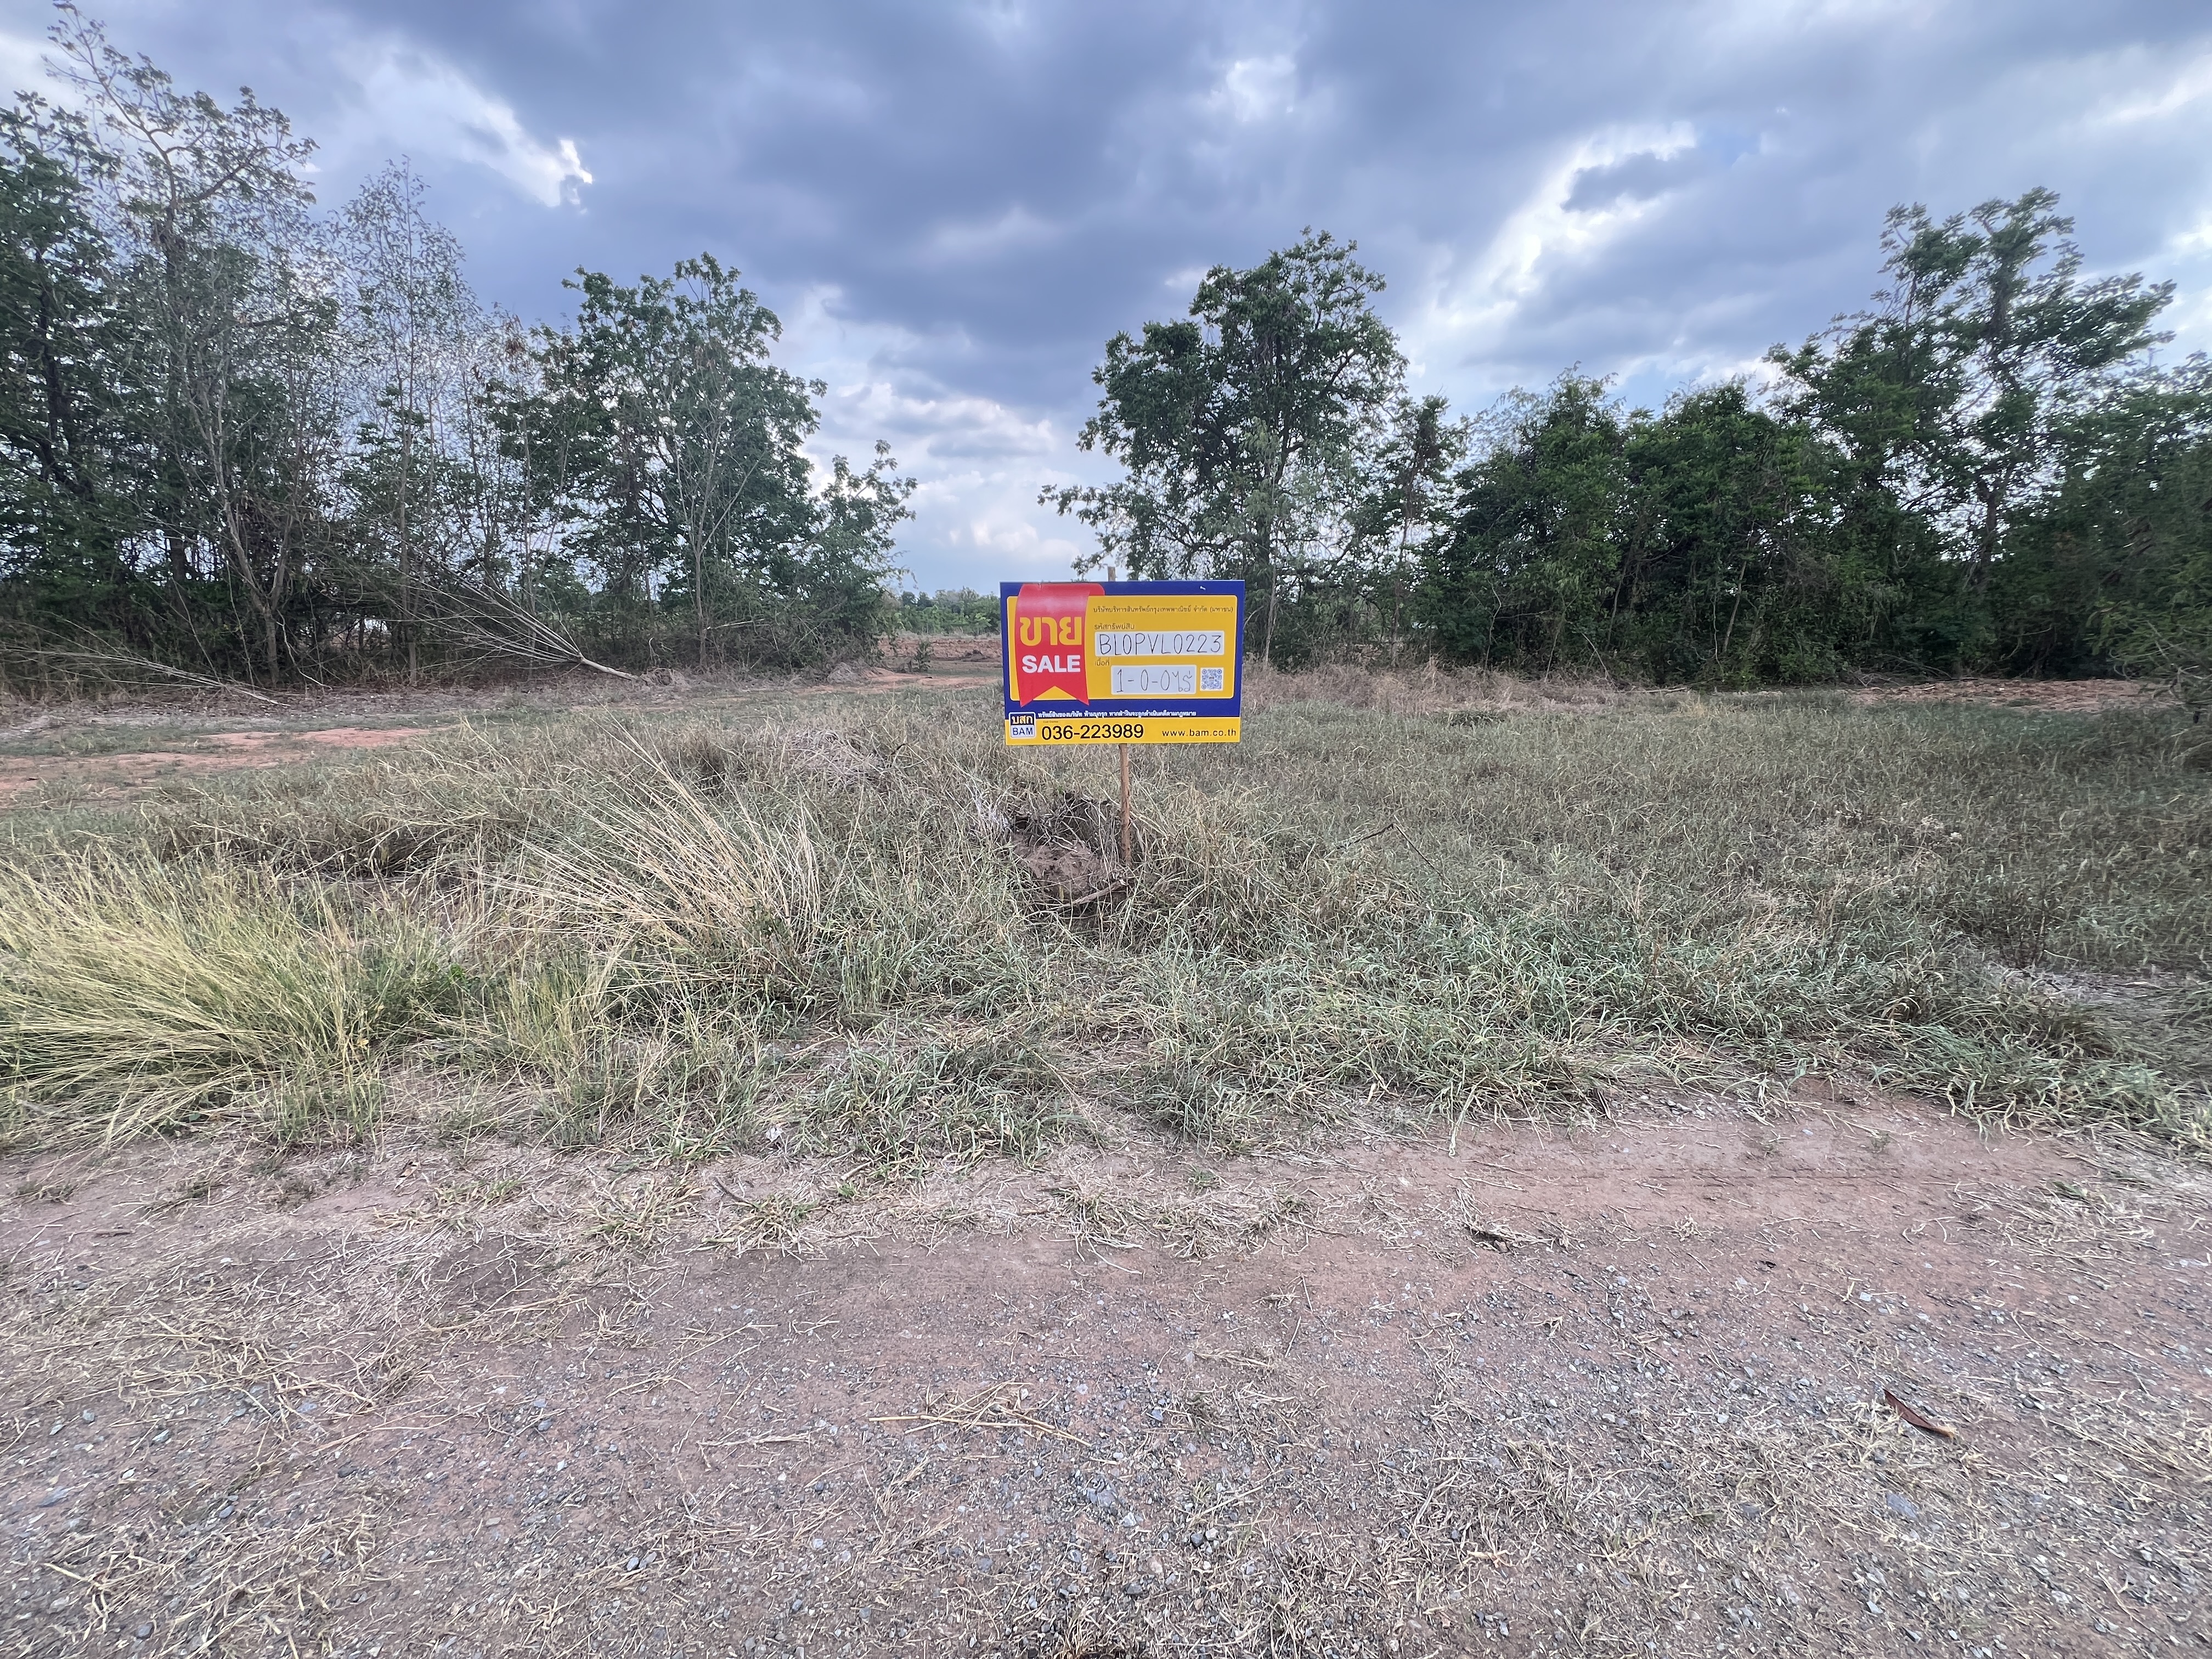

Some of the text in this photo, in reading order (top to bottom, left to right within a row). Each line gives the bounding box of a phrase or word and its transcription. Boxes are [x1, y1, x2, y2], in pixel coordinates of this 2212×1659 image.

[1020, 617, 1082, 646] ขาย
[1022, 654, 1081, 673] SALE
[1012, 715, 1033, 724] บสก
[1041, 724, 1144, 740] 036-223989
[1162, 728, 1237, 737] www.bam.co.th
